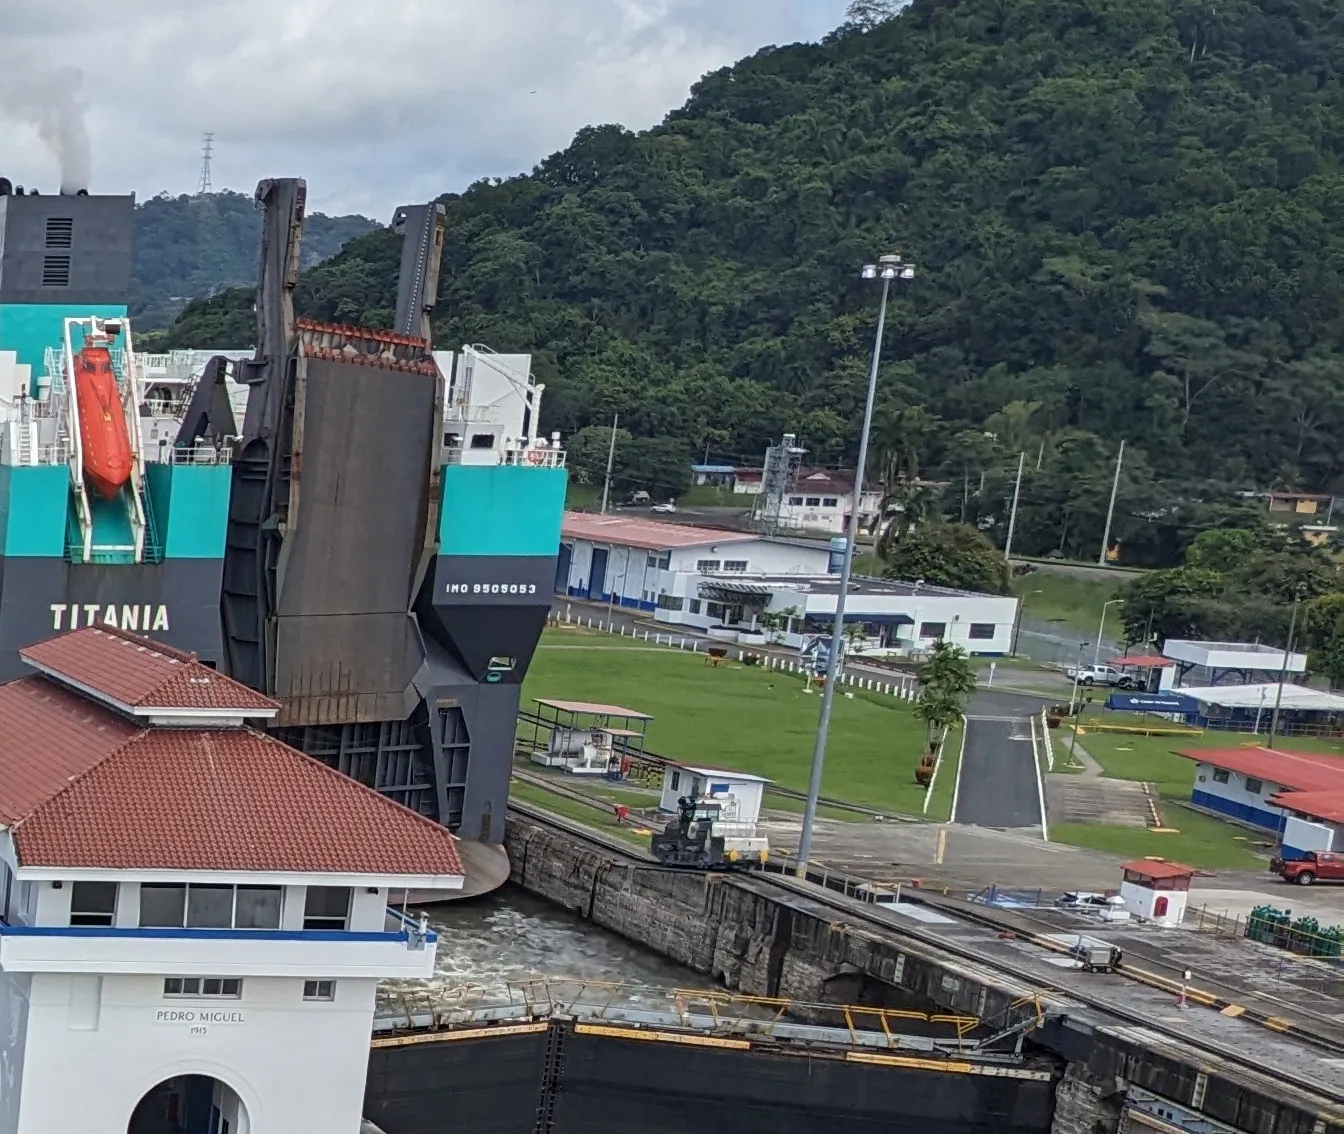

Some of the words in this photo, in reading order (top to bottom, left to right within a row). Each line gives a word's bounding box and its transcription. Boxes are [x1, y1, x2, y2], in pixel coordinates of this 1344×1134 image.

[446, 584, 468, 593] IMO
[50, 604, 170, 631] TITANIA
[156, 1010, 195, 1022] PEDRO
[199, 1011, 245, 1023] MIGUEL
